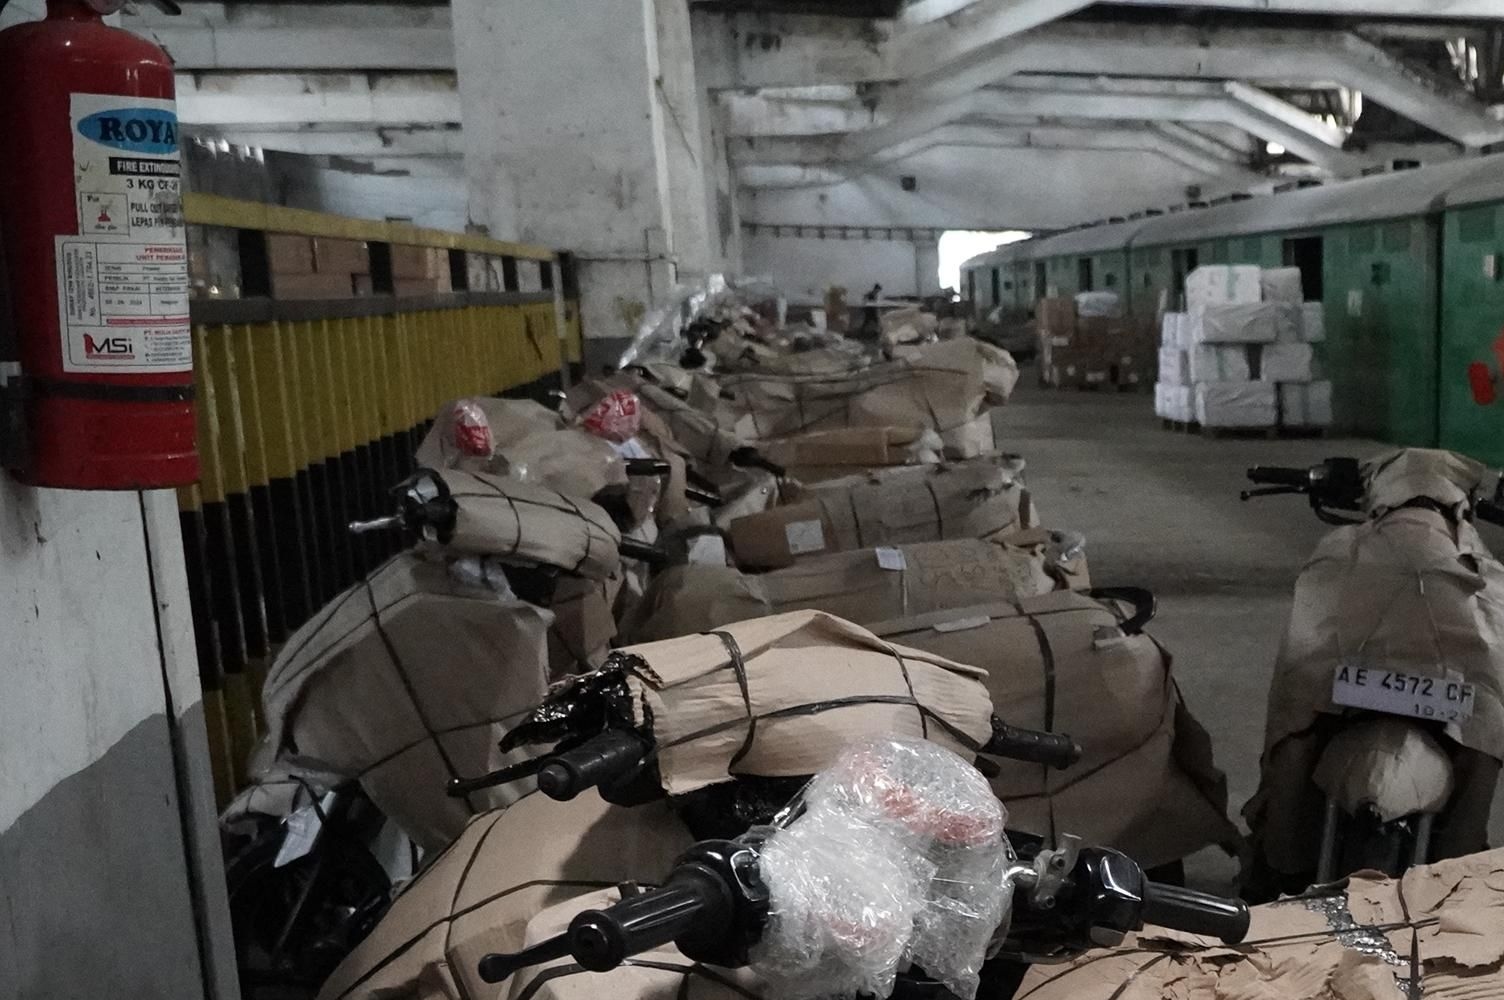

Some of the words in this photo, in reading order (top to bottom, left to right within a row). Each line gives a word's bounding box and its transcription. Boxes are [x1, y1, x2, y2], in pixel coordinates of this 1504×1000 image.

[98, 117, 178, 145] ROYA
[116, 160, 138, 172] FIRE
[126, 178, 134, 189] 3
[138, 179, 155, 190] KG
[130, 202, 148, 213] PULL
[131, 217, 153, 228] LEPAS
[1338, 666, 1368, 686] AE
[1381, 672, 1434, 697] 4572
